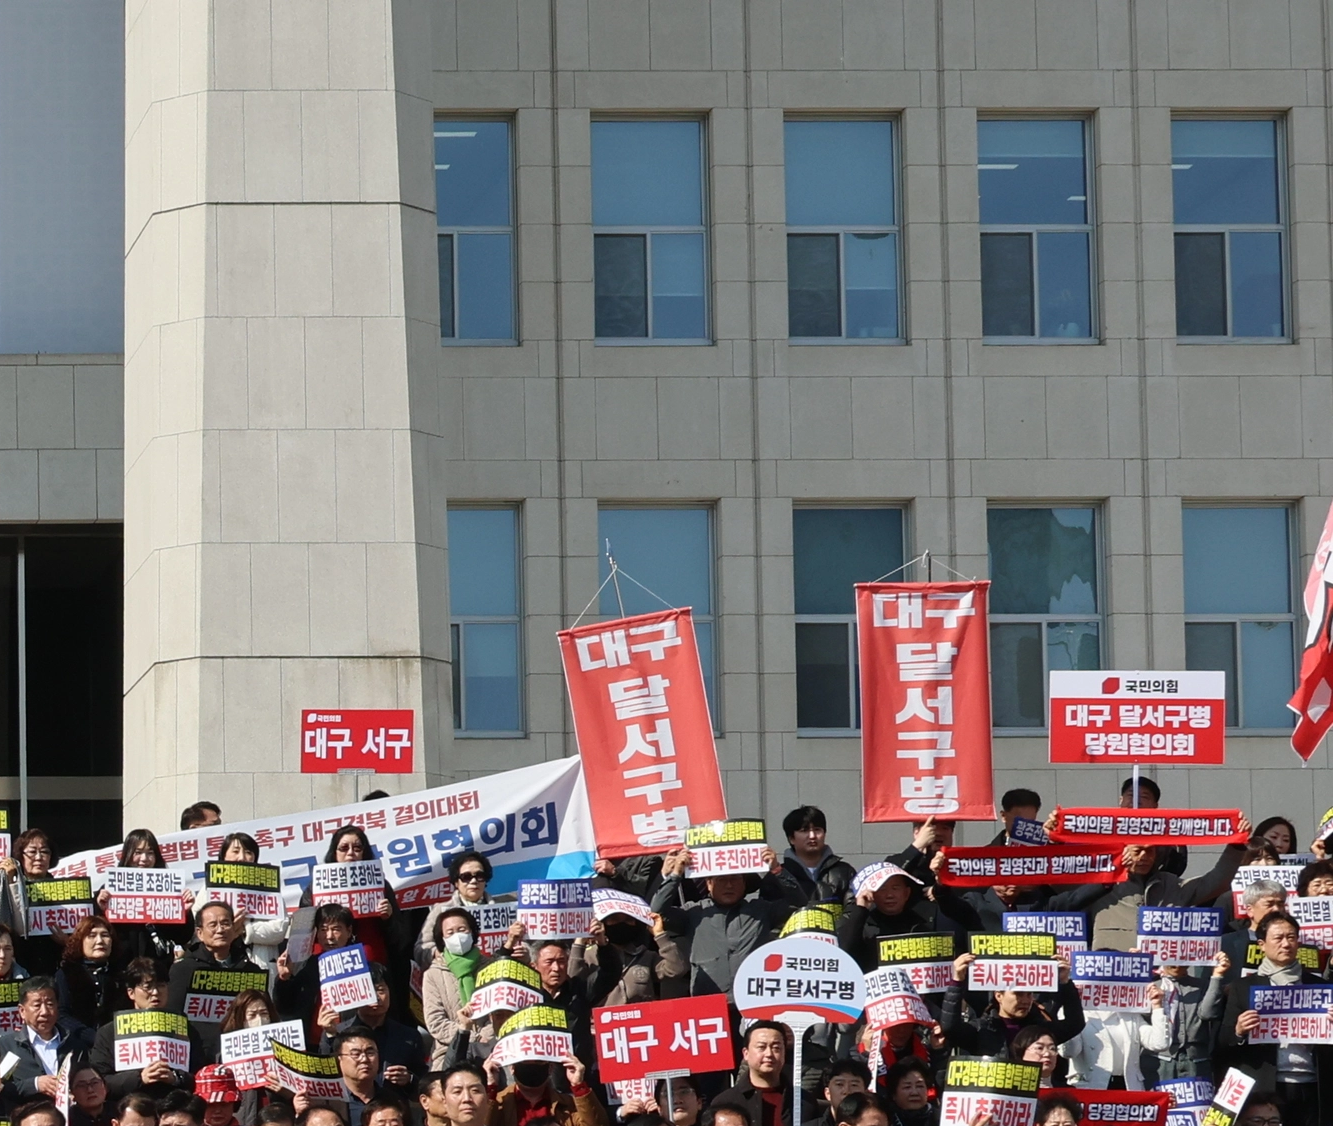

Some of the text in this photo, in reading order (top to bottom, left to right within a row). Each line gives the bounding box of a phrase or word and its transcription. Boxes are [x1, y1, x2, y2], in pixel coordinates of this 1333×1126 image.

[872, 592, 976, 629] 대구
[575, 619, 682, 672] 대구
[1125, 679, 1178, 694] 국민의힘
[894, 643, 959, 814] 달서구병
[1065, 705, 1211, 728] 대구 달서구병
[305, 728, 411, 759] 대구 서구
[1085, 733, 1194, 756] 당원협의회
[607, 677, 690, 848] 달서구병
[393, 790, 481, 824] 결의대회
[1064, 815, 1233, 837] 국회의원 권영진과 함께합니다.
[948, 855, 1115, 877] 국회의원 권영진과 함께합니다.
[785, 957, 839, 973] 국민의힘
[1001, 961, 1057, 987] 추진하라
[748, 978, 855, 999] 대구 달서구병
[116, 1014, 188, 1037] 대구경북행정통합특별법
[600, 1017, 728, 1064] 대구 서구
[116, 1041, 142, 1068] 즉시
[1088, 1103, 1158, 1121] 당원협의회
